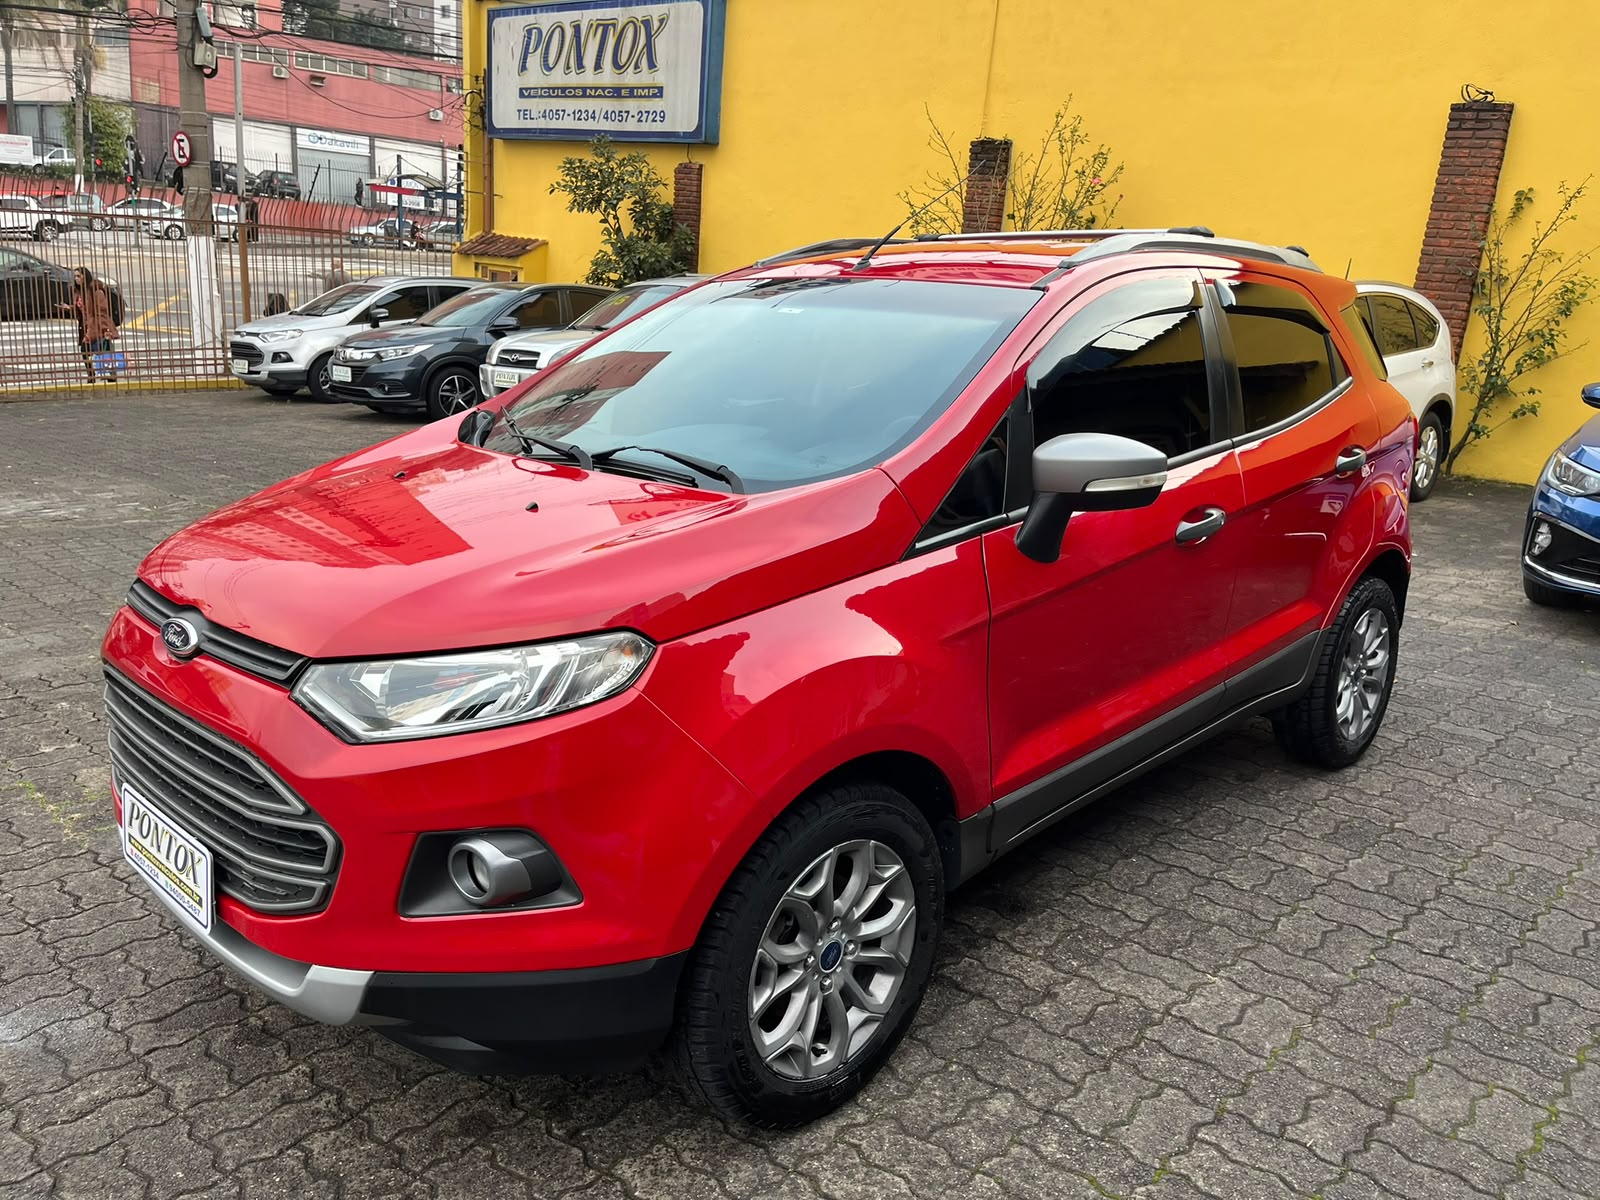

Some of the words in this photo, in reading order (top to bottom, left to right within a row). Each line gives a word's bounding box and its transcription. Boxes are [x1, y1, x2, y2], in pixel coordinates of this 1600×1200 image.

[517, 14, 670, 77] PONTOX
[586, 88, 617, 97] NAC.
[621, 88, 630, 97] E
[633, 88, 660, 97] IMP.
[128, 801, 202, 888] PONTOX
